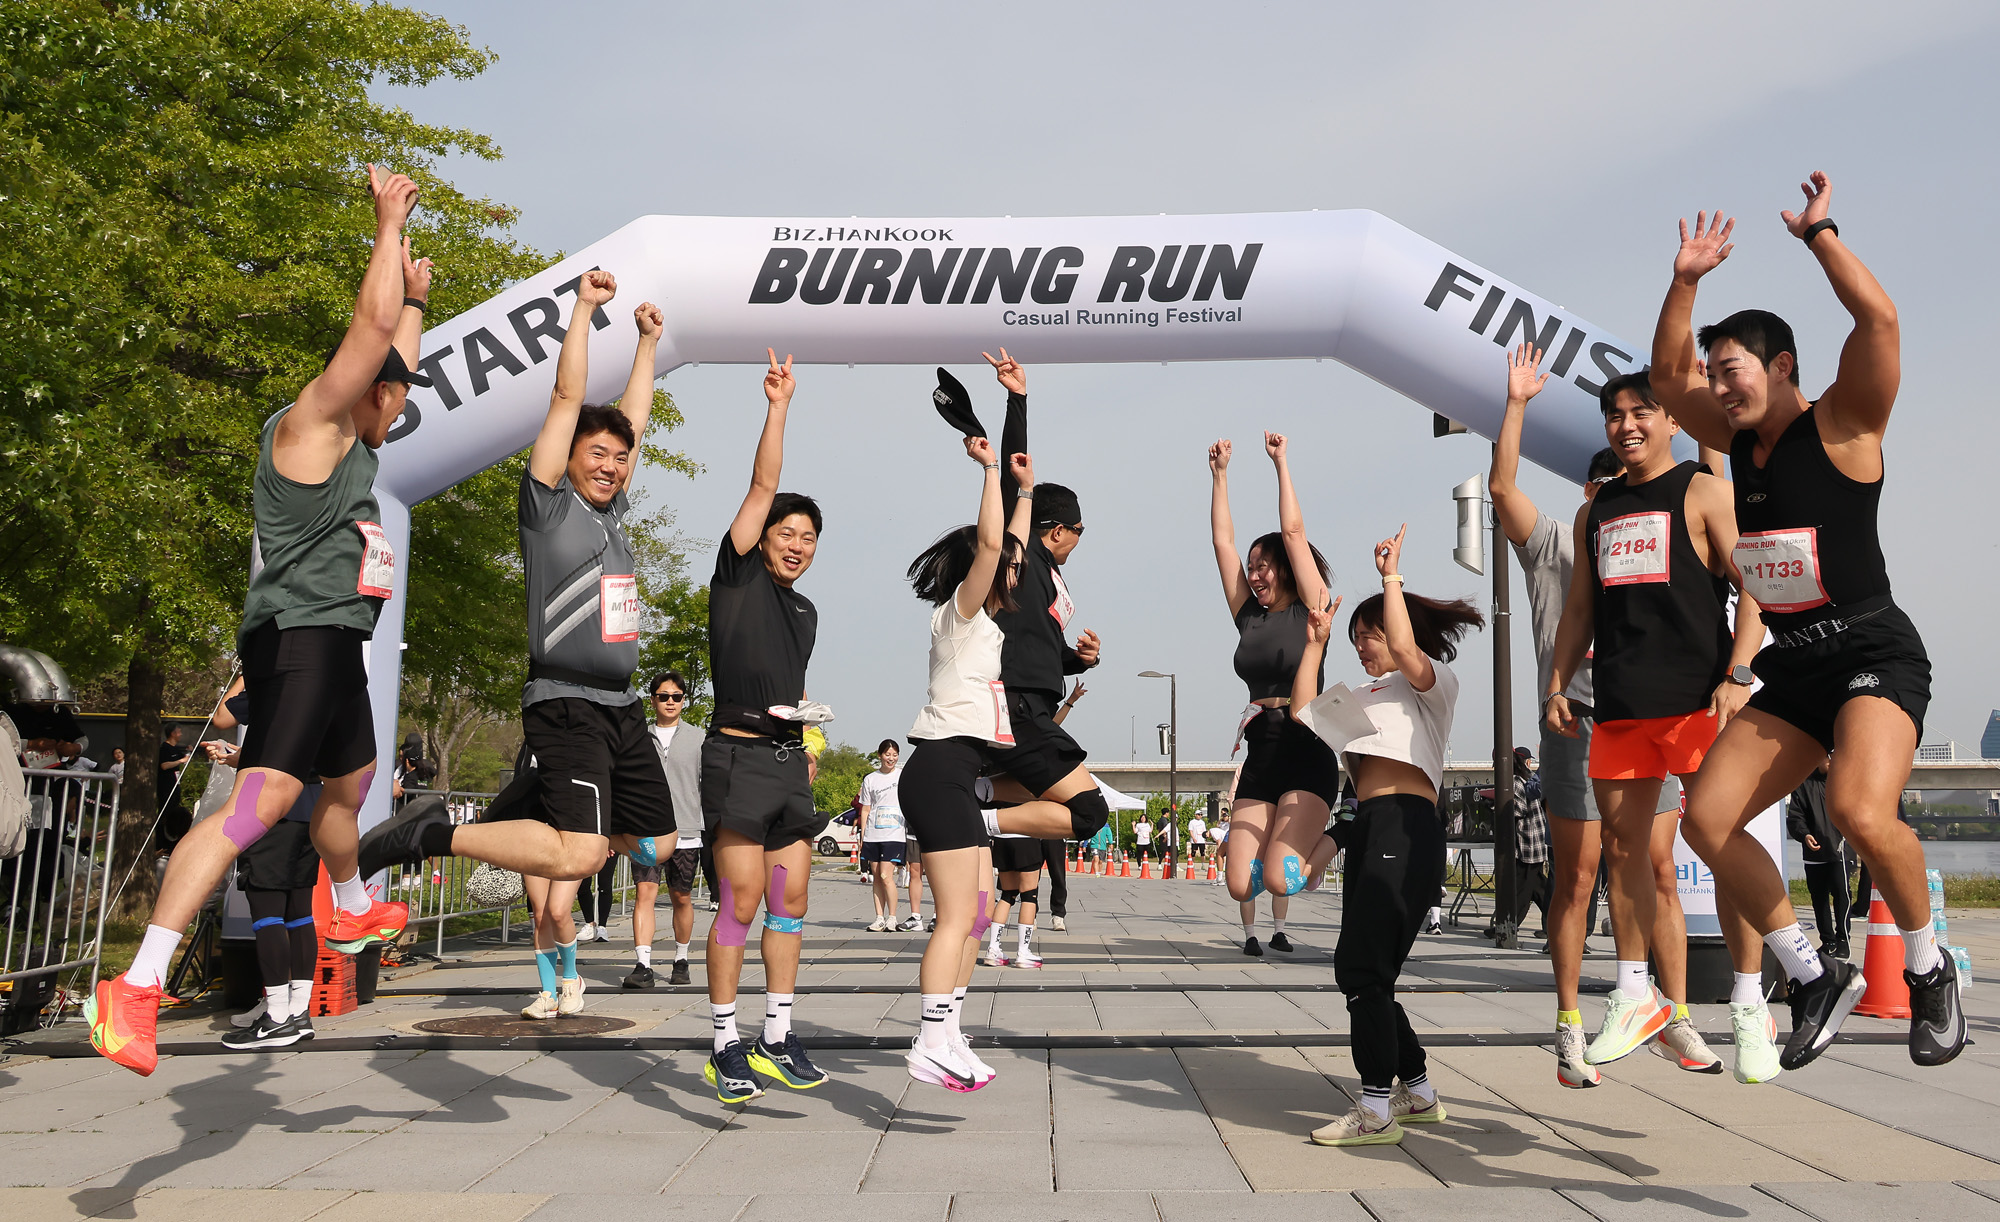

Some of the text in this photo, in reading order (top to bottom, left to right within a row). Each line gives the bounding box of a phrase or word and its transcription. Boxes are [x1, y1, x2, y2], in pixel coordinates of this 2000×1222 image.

[748, 243, 1264, 305] BURNING RUN
[1003, 306, 1242, 328] Casual Running Festival
[1423, 262, 1652, 398] FINIS
[1624, 521, 1639, 529] RUN
[1610, 537, 1657, 556] 2184
[1760, 540, 1777, 549] RUN
[1743, 560, 1804, 578] M 1733
[611, 599, 640, 613] M 173
